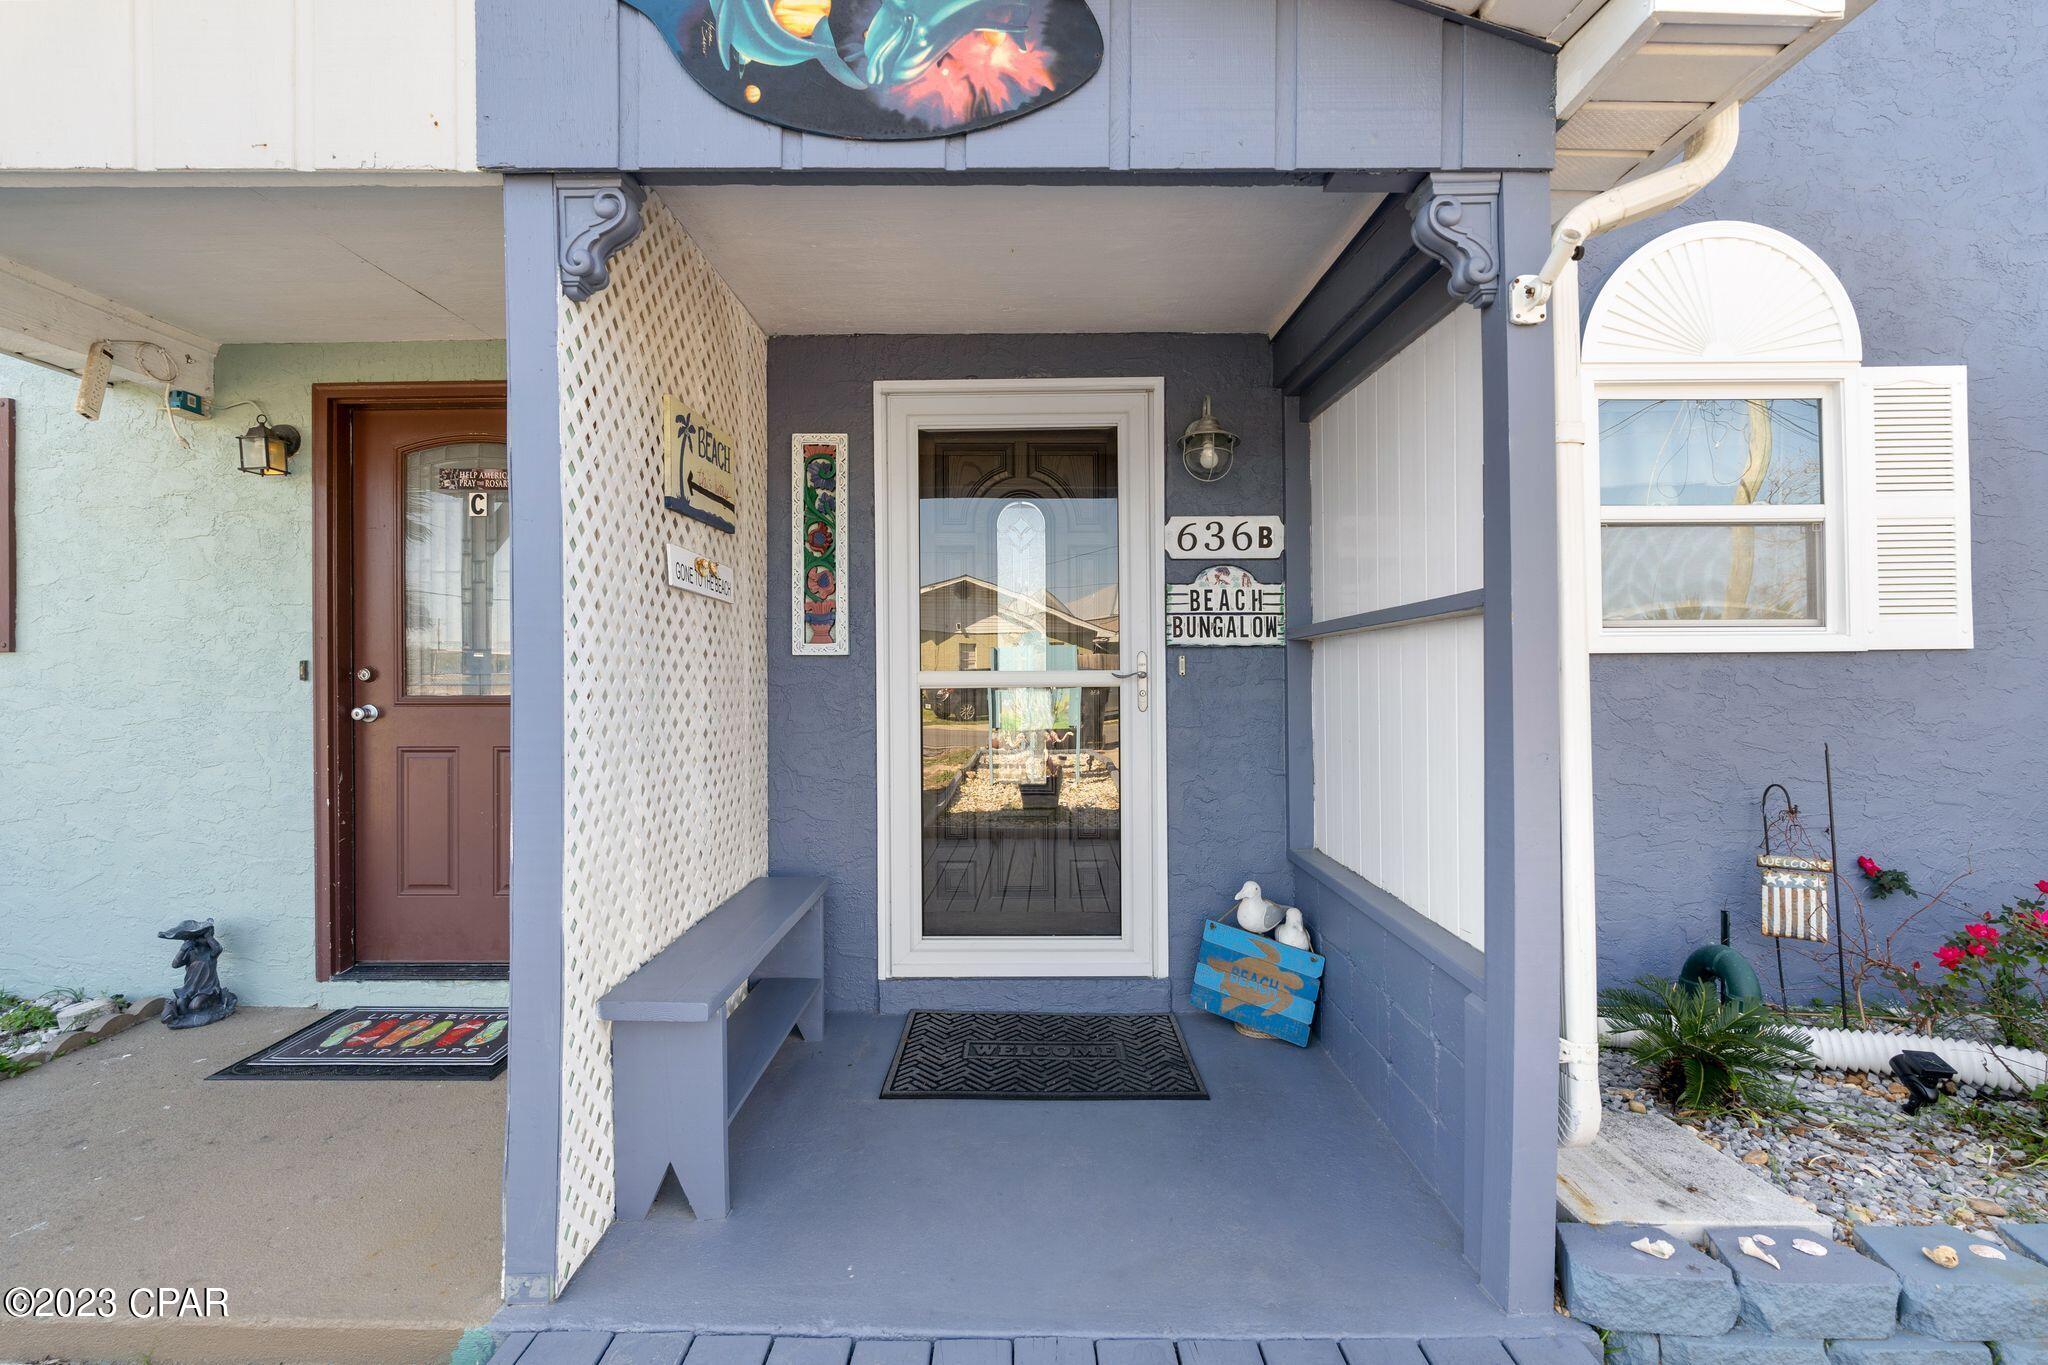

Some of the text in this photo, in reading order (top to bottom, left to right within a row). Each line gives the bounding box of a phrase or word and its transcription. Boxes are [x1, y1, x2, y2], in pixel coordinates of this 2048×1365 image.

[697, 426, 731, 473] BEACH
[459, 471, 508, 479] HELP AMERIC
[459, 479, 476, 487] PRAY
[485, 479, 508, 488] ROSAR
[471, 494, 485, 515] C
[675, 561, 694, 584] GONE
[715, 575, 732, 597] BEACH
[1189, 589, 1262, 611] BEACH
[1172, 615, 1277, 638] BUNGALOW
[1760, 857, 1830, 870] WELCOME
[1229, 966, 1281, 1001] BEACH
[400, 1047, 480, 1055] FLOPS
[970, 1043, 1117, 1057] WELCOME
